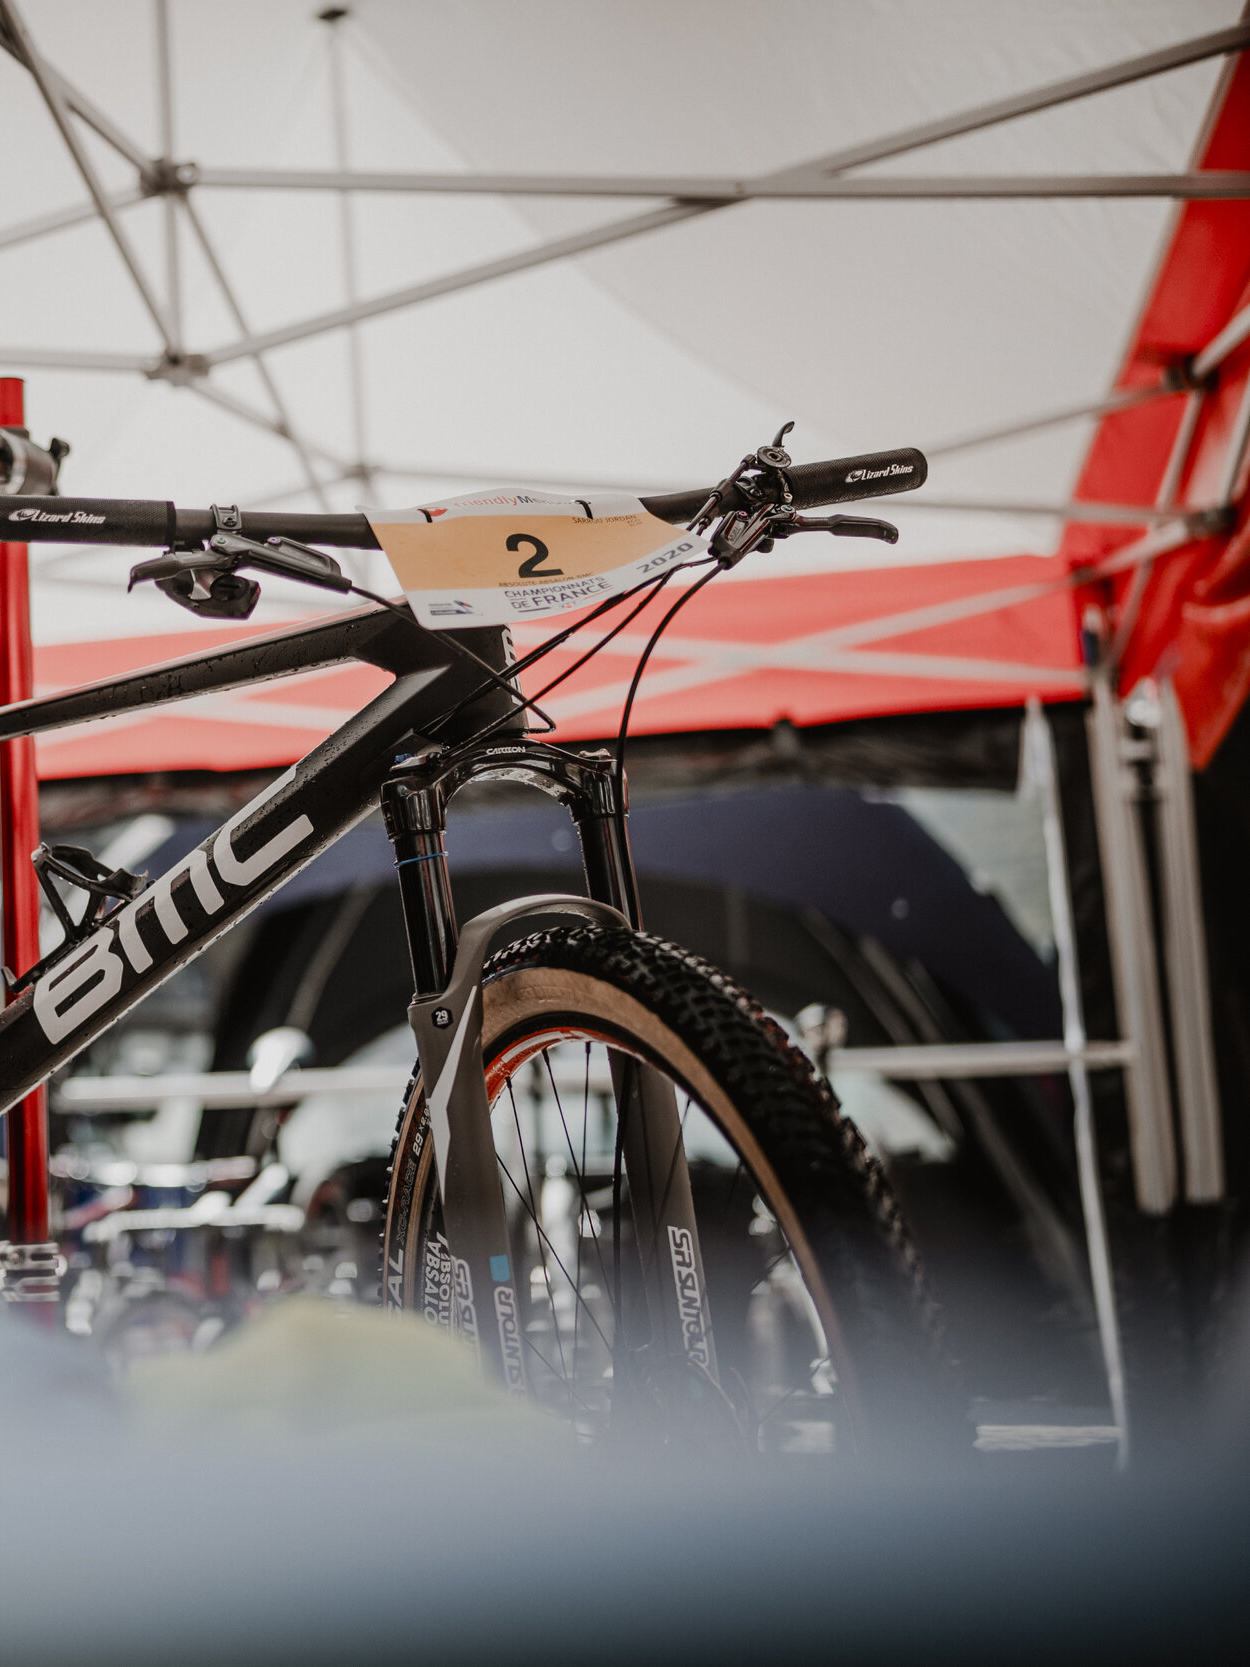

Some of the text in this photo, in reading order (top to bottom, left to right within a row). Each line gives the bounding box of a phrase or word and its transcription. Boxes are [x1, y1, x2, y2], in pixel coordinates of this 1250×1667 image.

[861, 463, 914, 480] Lizard Skins
[31, 509, 106, 524] Lizard Skins
[505, 533, 564, 578] 2
[636, 543, 693, 573] 2020
[504, 576, 606, 598] CHAMPIONNATS
[511, 600, 530, 609] DE
[531, 580, 613, 606] FRANCE
[33, 763, 314, 1045] BMC
[435, 1010, 448, 1021] 29
